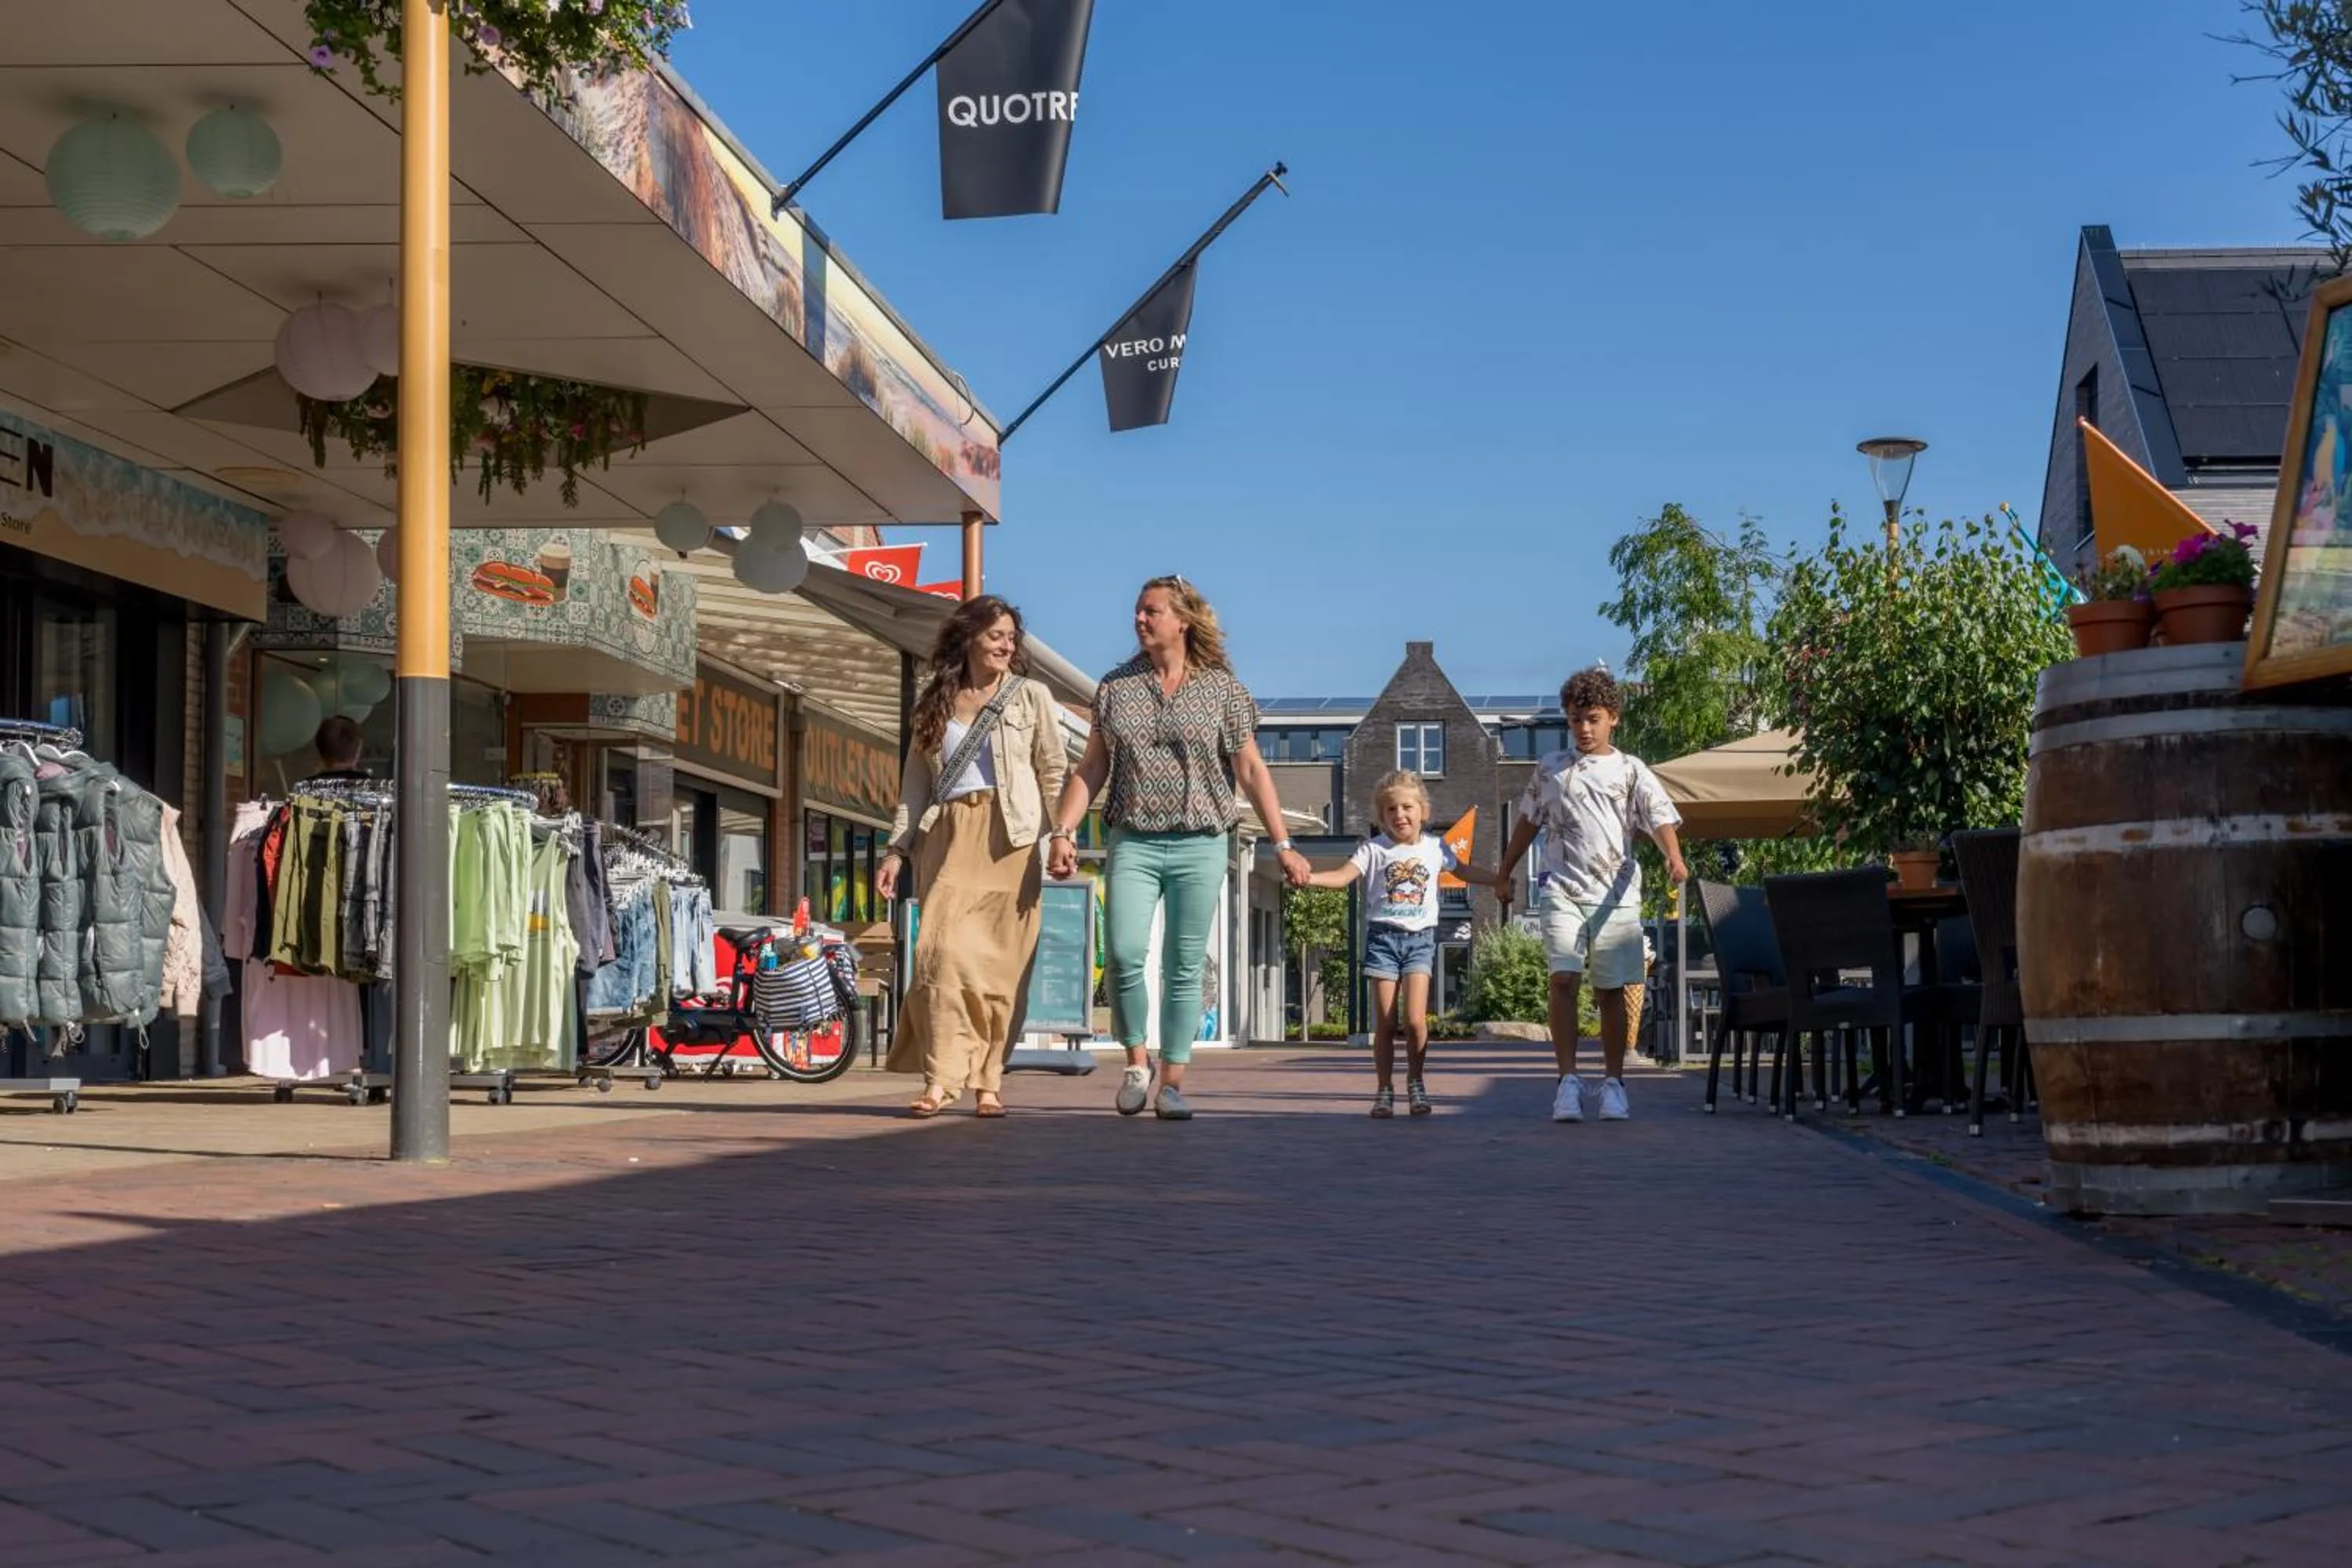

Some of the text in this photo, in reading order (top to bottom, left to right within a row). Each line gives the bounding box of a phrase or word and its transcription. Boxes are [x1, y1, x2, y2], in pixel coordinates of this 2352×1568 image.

[1105, 334, 1186, 358] VERO M
[1147, 356, 1180, 371] CUR
[710, 684, 775, 771] STORE
[804, 721, 864, 800] OUTLET
